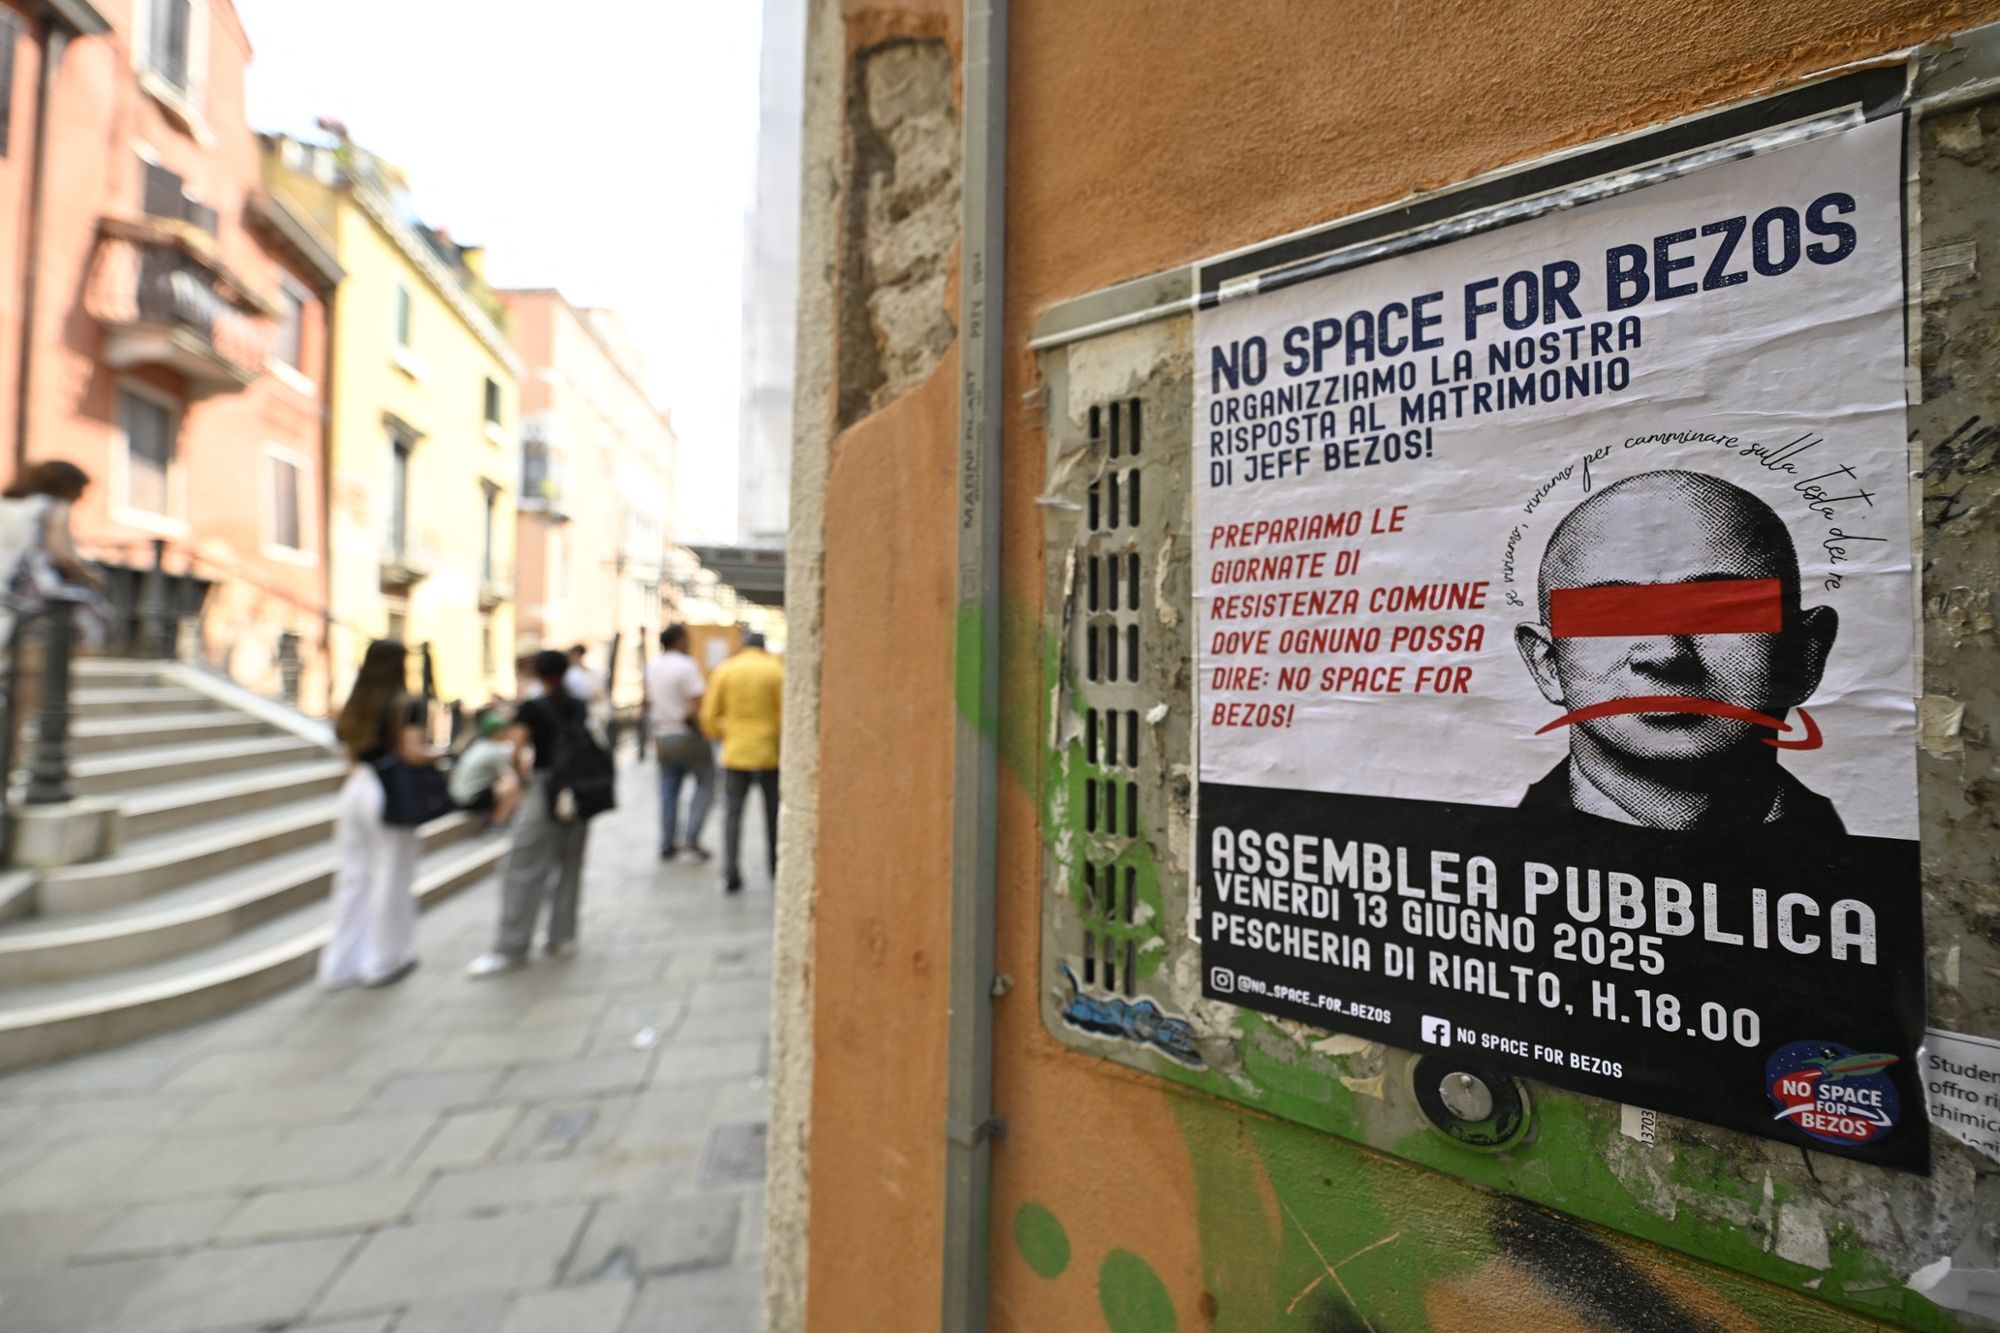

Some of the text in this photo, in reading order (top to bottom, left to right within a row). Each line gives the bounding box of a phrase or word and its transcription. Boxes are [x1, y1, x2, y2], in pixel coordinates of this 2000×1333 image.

[1211, 192, 1857, 394] NO SPACE FOR BEZOS
[1210, 316, 1641, 426] ORGANIZZIAMO LA NOSTRA
[1210, 357, 1630, 457] RISPOSTA AL MATRIMONIO
[1210, 427, 1433, 487] DI JEFF BEZOS!
[1624, 430, 1739, 449] camminare
[1739, 432, 1823, 475] sulla
[1524, 464, 1574, 514] viviamo
[1583, 445, 1612, 493] per
[1794, 464, 1875, 520] testa
[1210, 505, 1408, 550] PREPARIAMO LE
[1823, 527, 1888, 565] dei
[1210, 549, 1361, 584] GIORNATE DI
[1824, 572, 1843, 591] re
[1210, 581, 1490, 620] RESISTENZA COMUNE
[1506, 589, 1524, 607] se
[1210, 624, 1485, 655] DOVE OGNUNO POSSA
[1211, 666, 1472, 694] DIRE: NO SPACE FOR
[1211, 703, 1294, 728] BEZOS!
[1211, 826, 1877, 965] ASSEMBLEA PUBBLICA
[1213, 871, 1665, 975] VENERDI 13 GIUGNO 2025
[1211, 911, 1371, 972] PESCHERIA
[1384, 942, 1415, 981] DI
[1429, 950, 1574, 1015] RIALTO,
[1237, 974, 1392, 1024] @NO_SPACE_FOR_BEZOS
[1457, 1027, 1476, 1045] NO
[1481, 1033, 1529, 1058] SPACE
[1534, 1044, 1564, 1066] FOR
[1570, 1052, 1623, 1079] BEZOS
[1782, 1079, 1882, 1107] NO SPACE
[1817, 1100, 1848, 1116] FOR
[1929, 1081, 1979, 1103] offro
[1801, 1112, 1867, 1137] BEZOS
